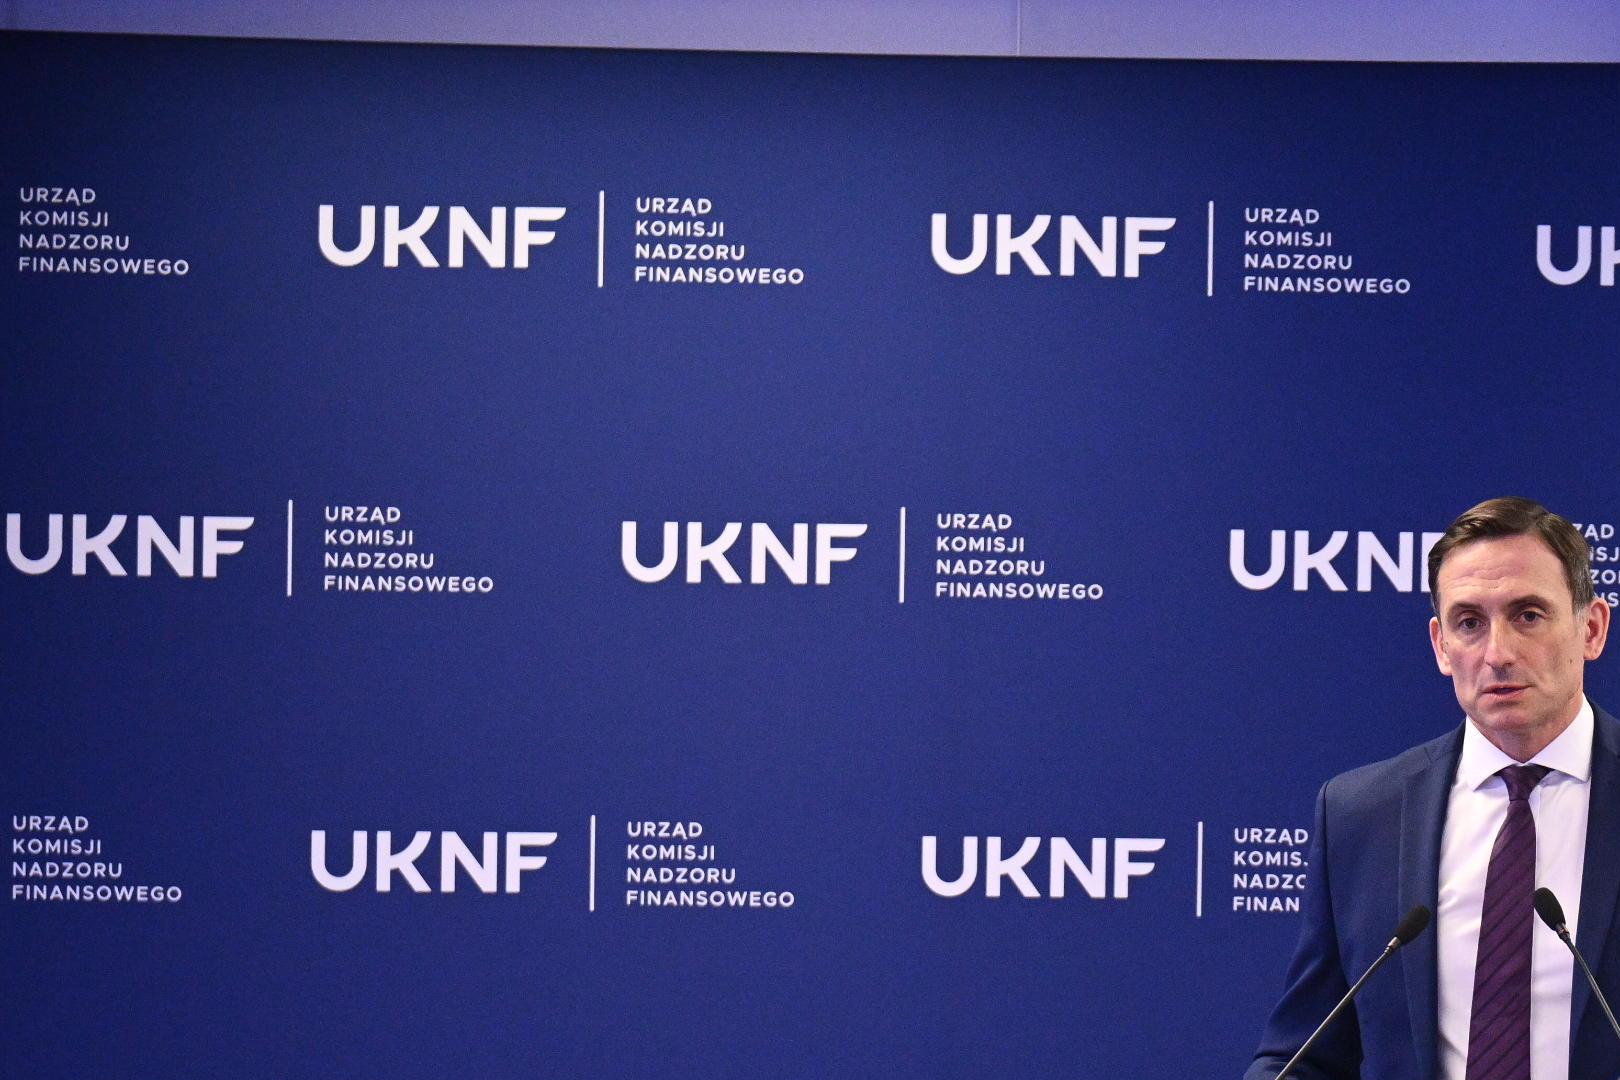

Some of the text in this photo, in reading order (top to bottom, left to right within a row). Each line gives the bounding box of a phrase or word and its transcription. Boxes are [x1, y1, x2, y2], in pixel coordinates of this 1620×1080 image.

[20, 187, 96, 206] URZĄD
[636, 197, 712, 217] URZĄD
[20, 210, 108, 227] KOMISJI
[1245, 207, 1320, 227] URZĄD
[318, 204, 567, 269] UKNF
[635, 220, 724, 238] KOMISJI
[1244, 230, 1332, 247] KOMISJI
[19, 233, 130, 251] NADZORU
[931, 212, 1177, 278] UKNF
[635, 243, 745, 261] NADZORU
[1244, 253, 1352, 270] NADZORU
[19, 256, 190, 276] FINANSOWEGO
[634, 265, 804, 285] FINANSOWEGO
[1244, 275, 1411, 294] FINANSOWEGO
[325, 506, 401, 525] URZĄD
[936, 513, 1012, 532] URZĄD
[6, 513, 255, 578] UKNF
[324, 529, 413, 546] KOMISJI
[936, 535, 1025, 553] KOMISJI
[324, 551, 434, 569] NADZORU
[621, 520, 868, 585] UKNF
[936, 558, 1045, 576] NADZORU
[324, 575, 494, 593] FINANSOWEGO
[935, 581, 1104, 600] FINANSOWEGO
[13, 815, 89, 834] URZĄD
[627, 821, 703, 840] URZĄD
[1233, 827, 1309, 846] URZĄD
[12, 838, 101, 855] KOMISJI
[627, 844, 715, 861] KOMISJI
[310, 829, 558, 894] UKNF
[921, 835, 1166, 899] UKNF
[1233, 850, 1309, 867] KOMIS
[12, 861, 122, 878] NADZORU
[626, 867, 736, 884] NADZORU
[1233, 873, 1307, 890] NADZO
[12, 884, 182, 902] FINANSOWEGO
[626, 889, 795, 908] FINANSOWEGO
